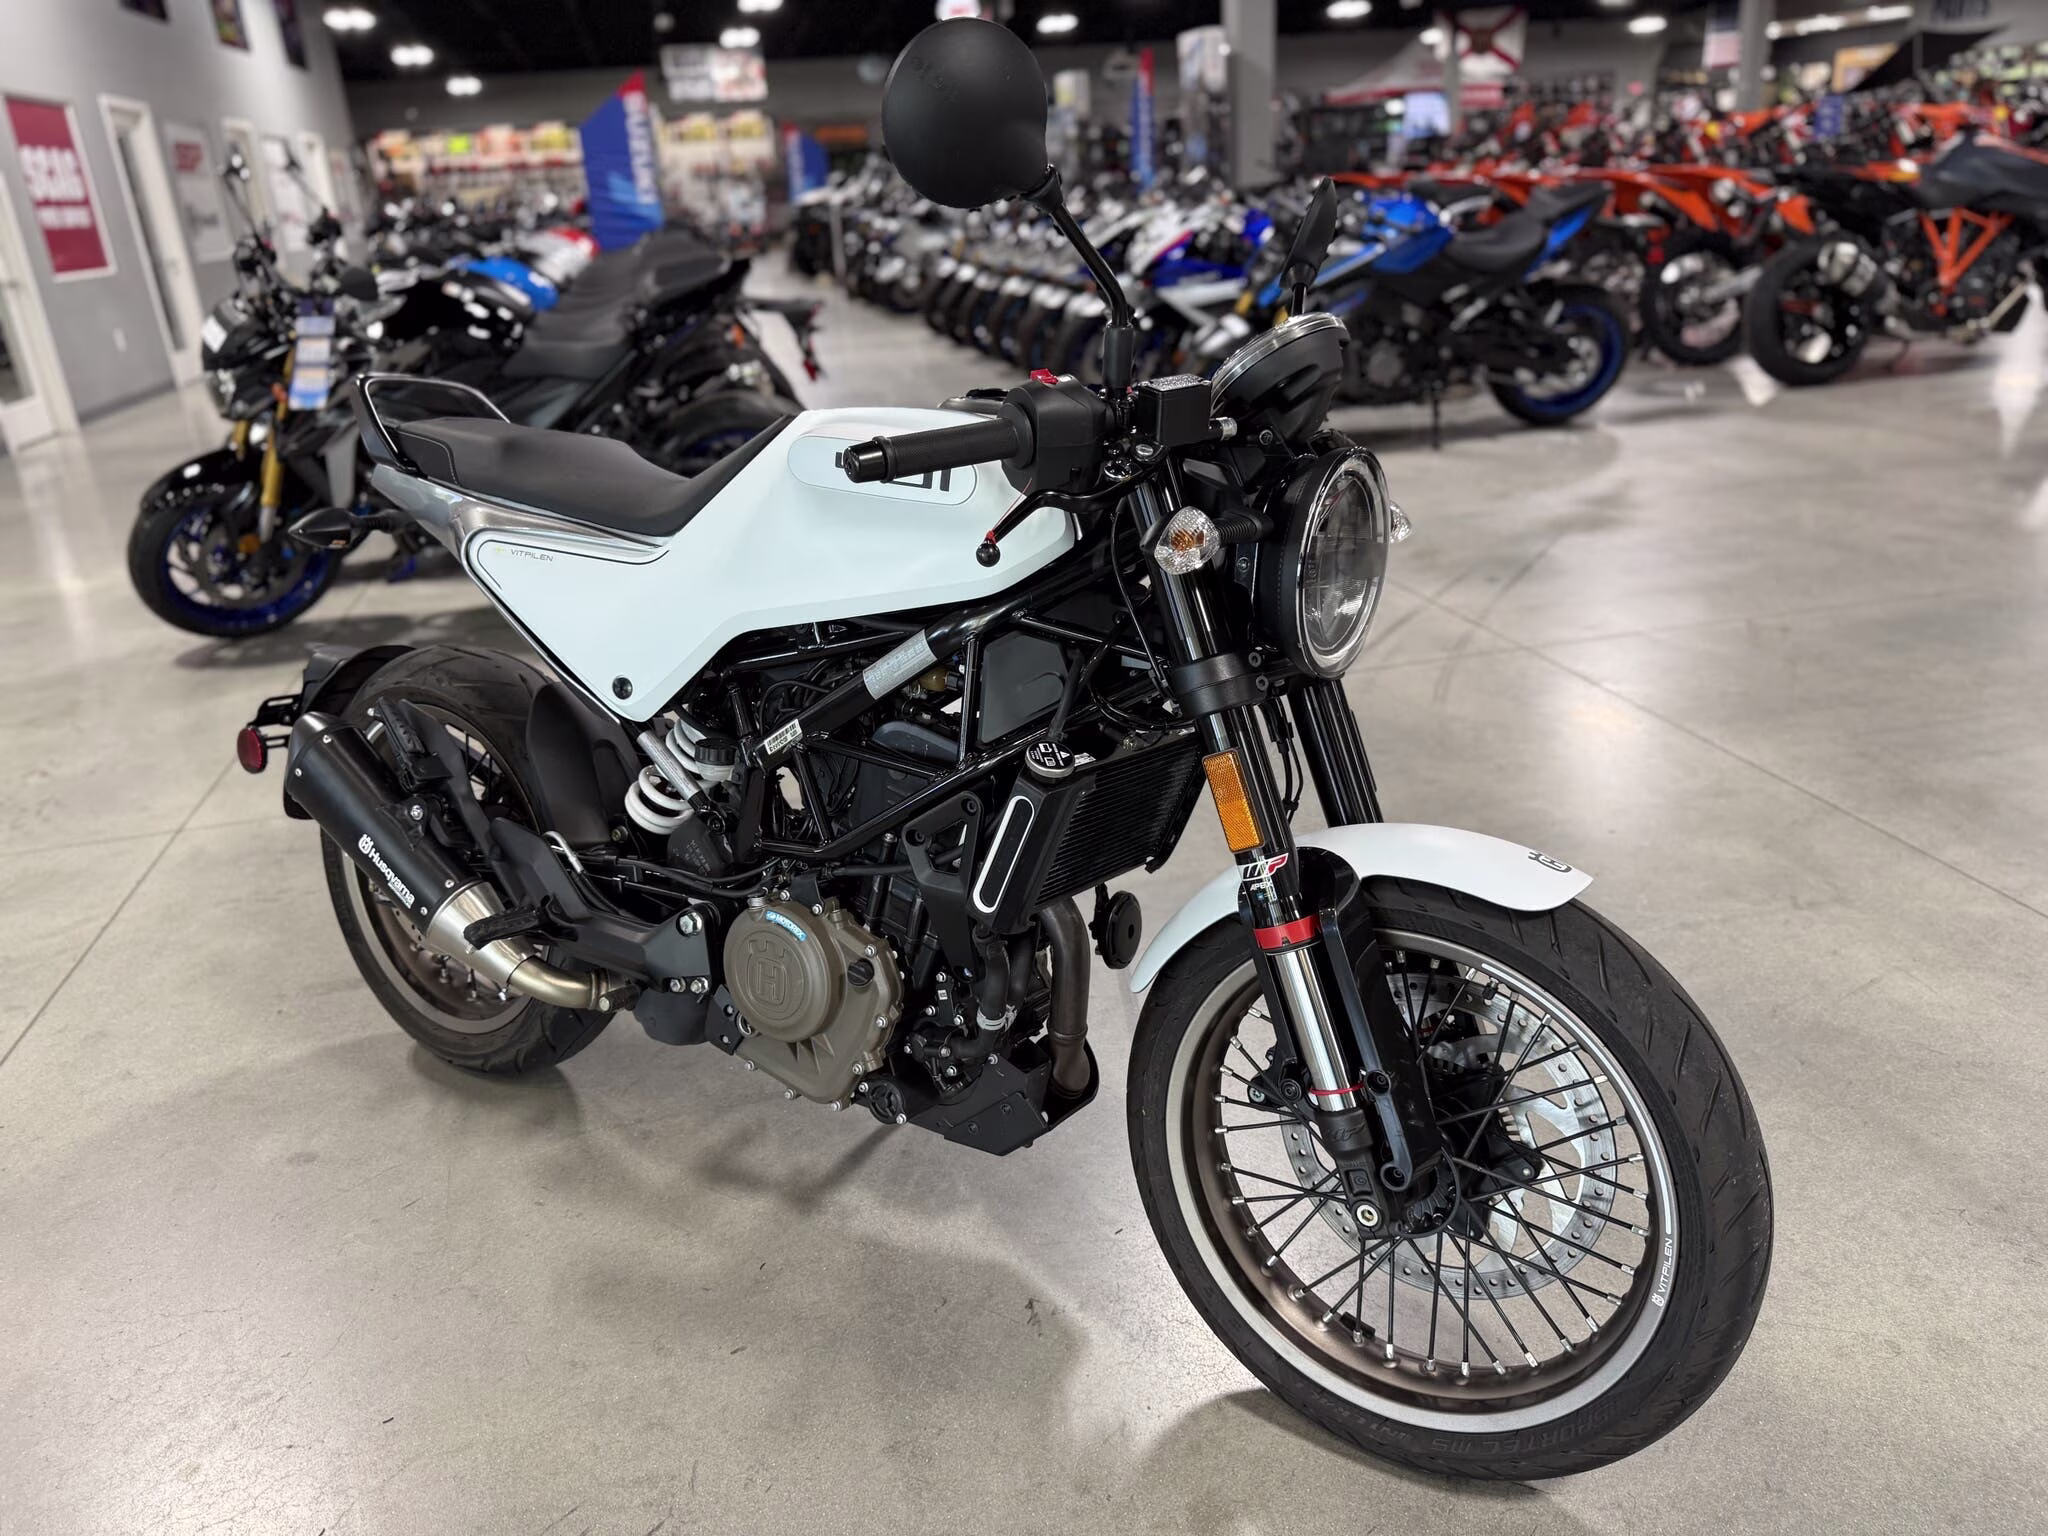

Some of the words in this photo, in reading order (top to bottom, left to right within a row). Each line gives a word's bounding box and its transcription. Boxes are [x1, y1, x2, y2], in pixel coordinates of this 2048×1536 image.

[510, 548, 554, 562] VITPILEN
[369, 847, 416, 905] Husqvarna
[1657, 1237, 1673, 1293] VITPILEN
